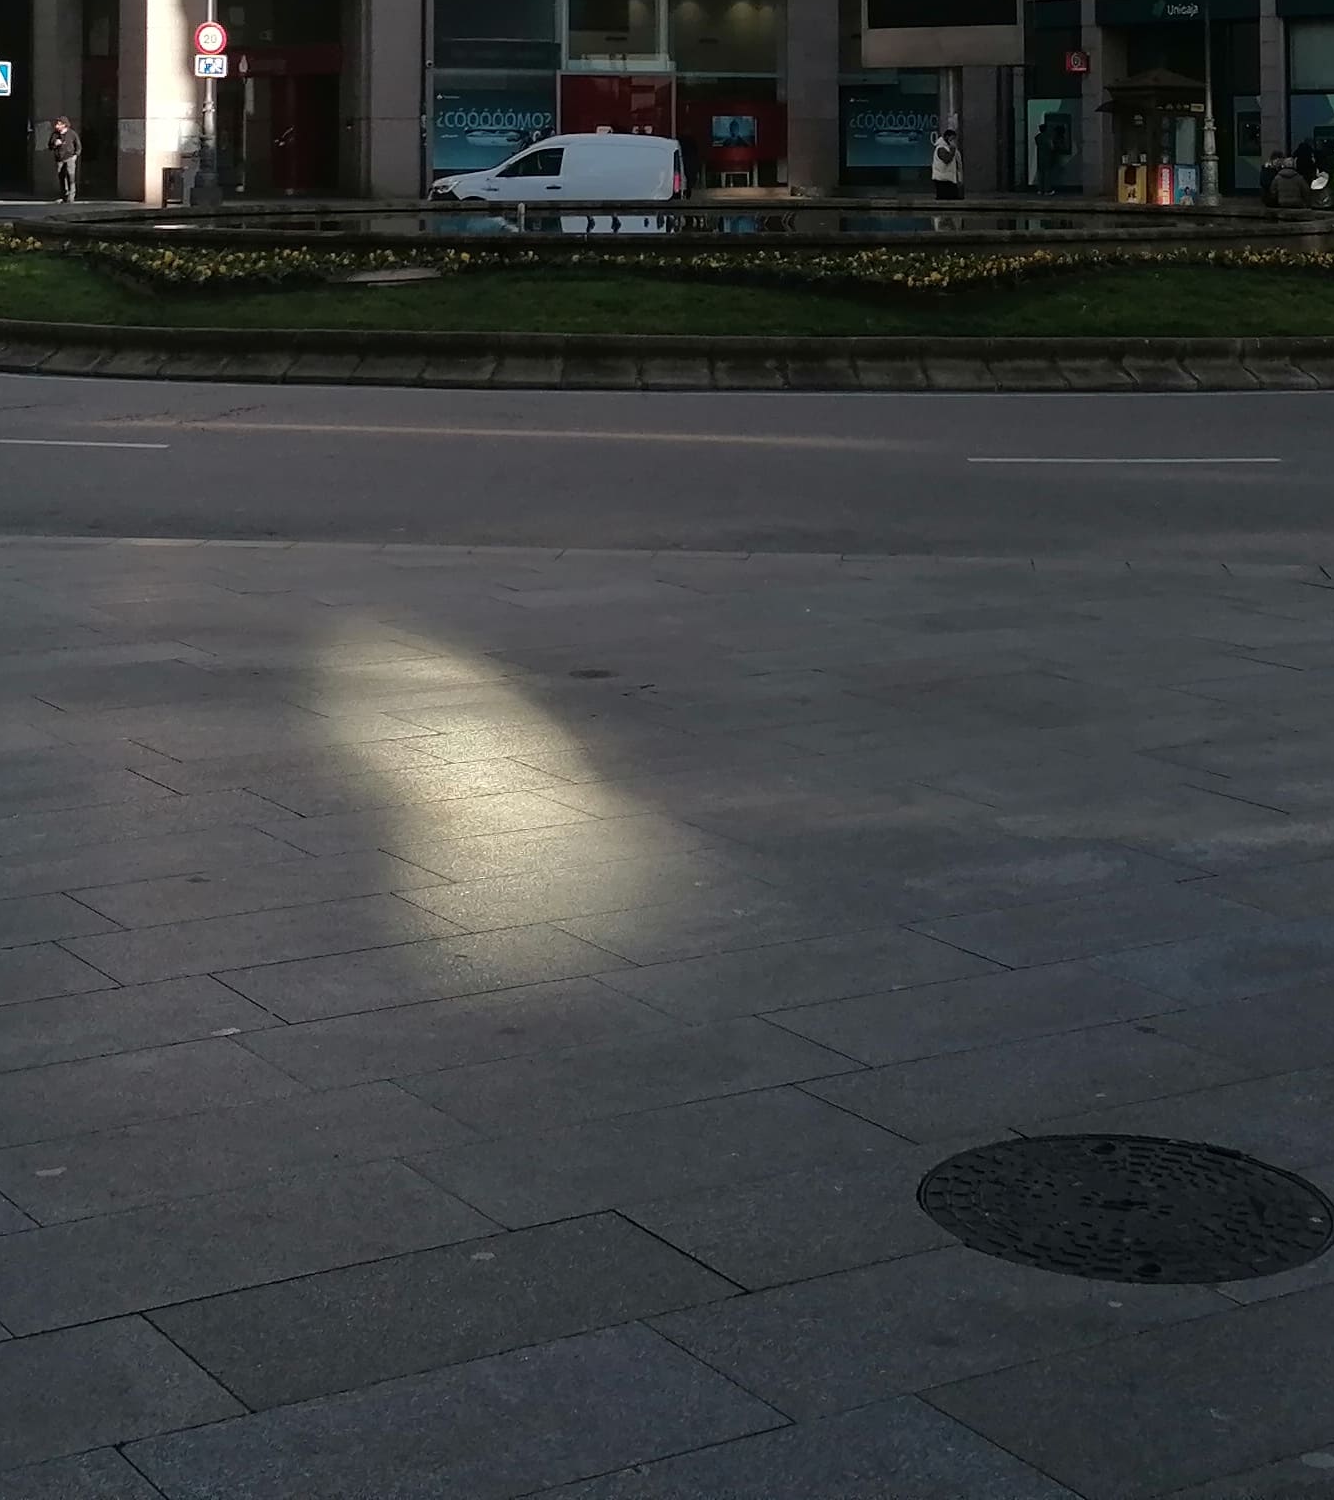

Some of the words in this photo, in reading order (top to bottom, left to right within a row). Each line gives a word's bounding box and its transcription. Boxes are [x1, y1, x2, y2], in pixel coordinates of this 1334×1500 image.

[1167, 3, 1200, 18] Unicaja
[203, 34, 217, 44] 20
[849, 110, 939, 129] ¿CÓÓÓÓÓMO
